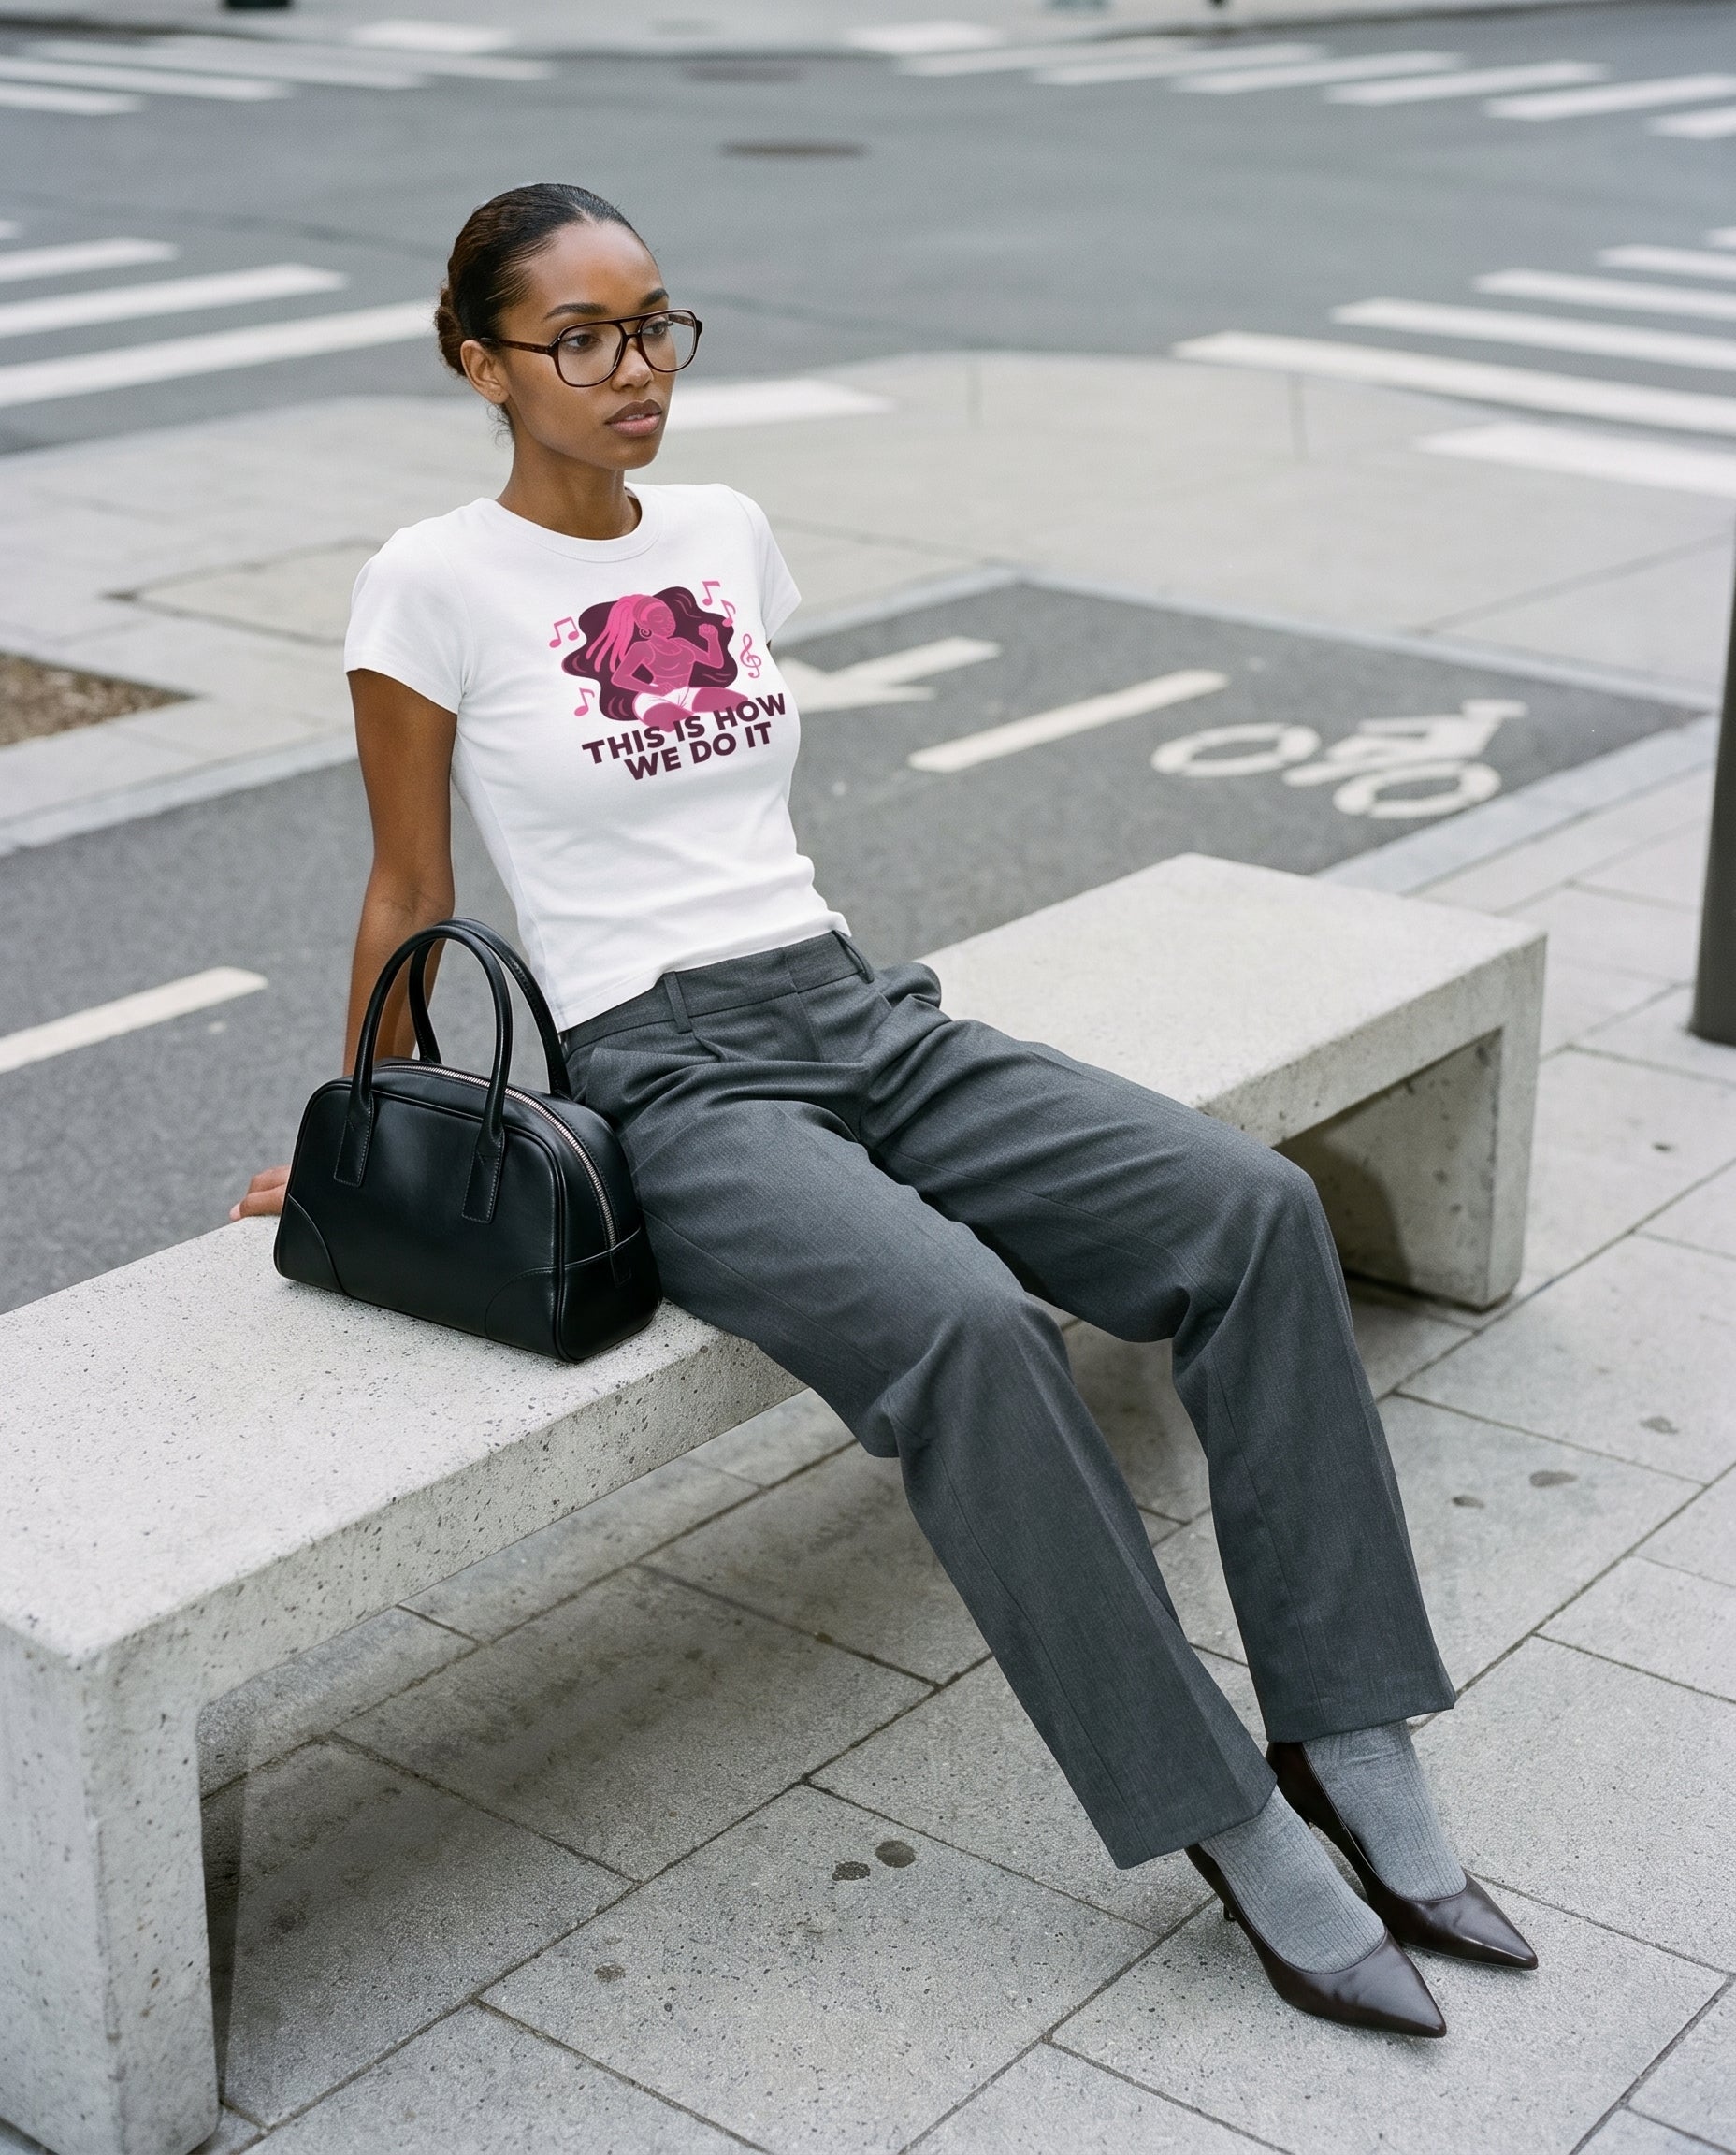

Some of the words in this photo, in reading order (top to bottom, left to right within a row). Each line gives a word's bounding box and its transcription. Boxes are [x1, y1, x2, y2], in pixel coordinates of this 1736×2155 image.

[582, 726, 665, 764] THIS
[673, 716, 705, 742] IS
[713, 693, 786, 730] HOW
[624, 746, 682, 781] WE
[689, 733, 736, 764] DO
[745, 721, 772, 748] IT
